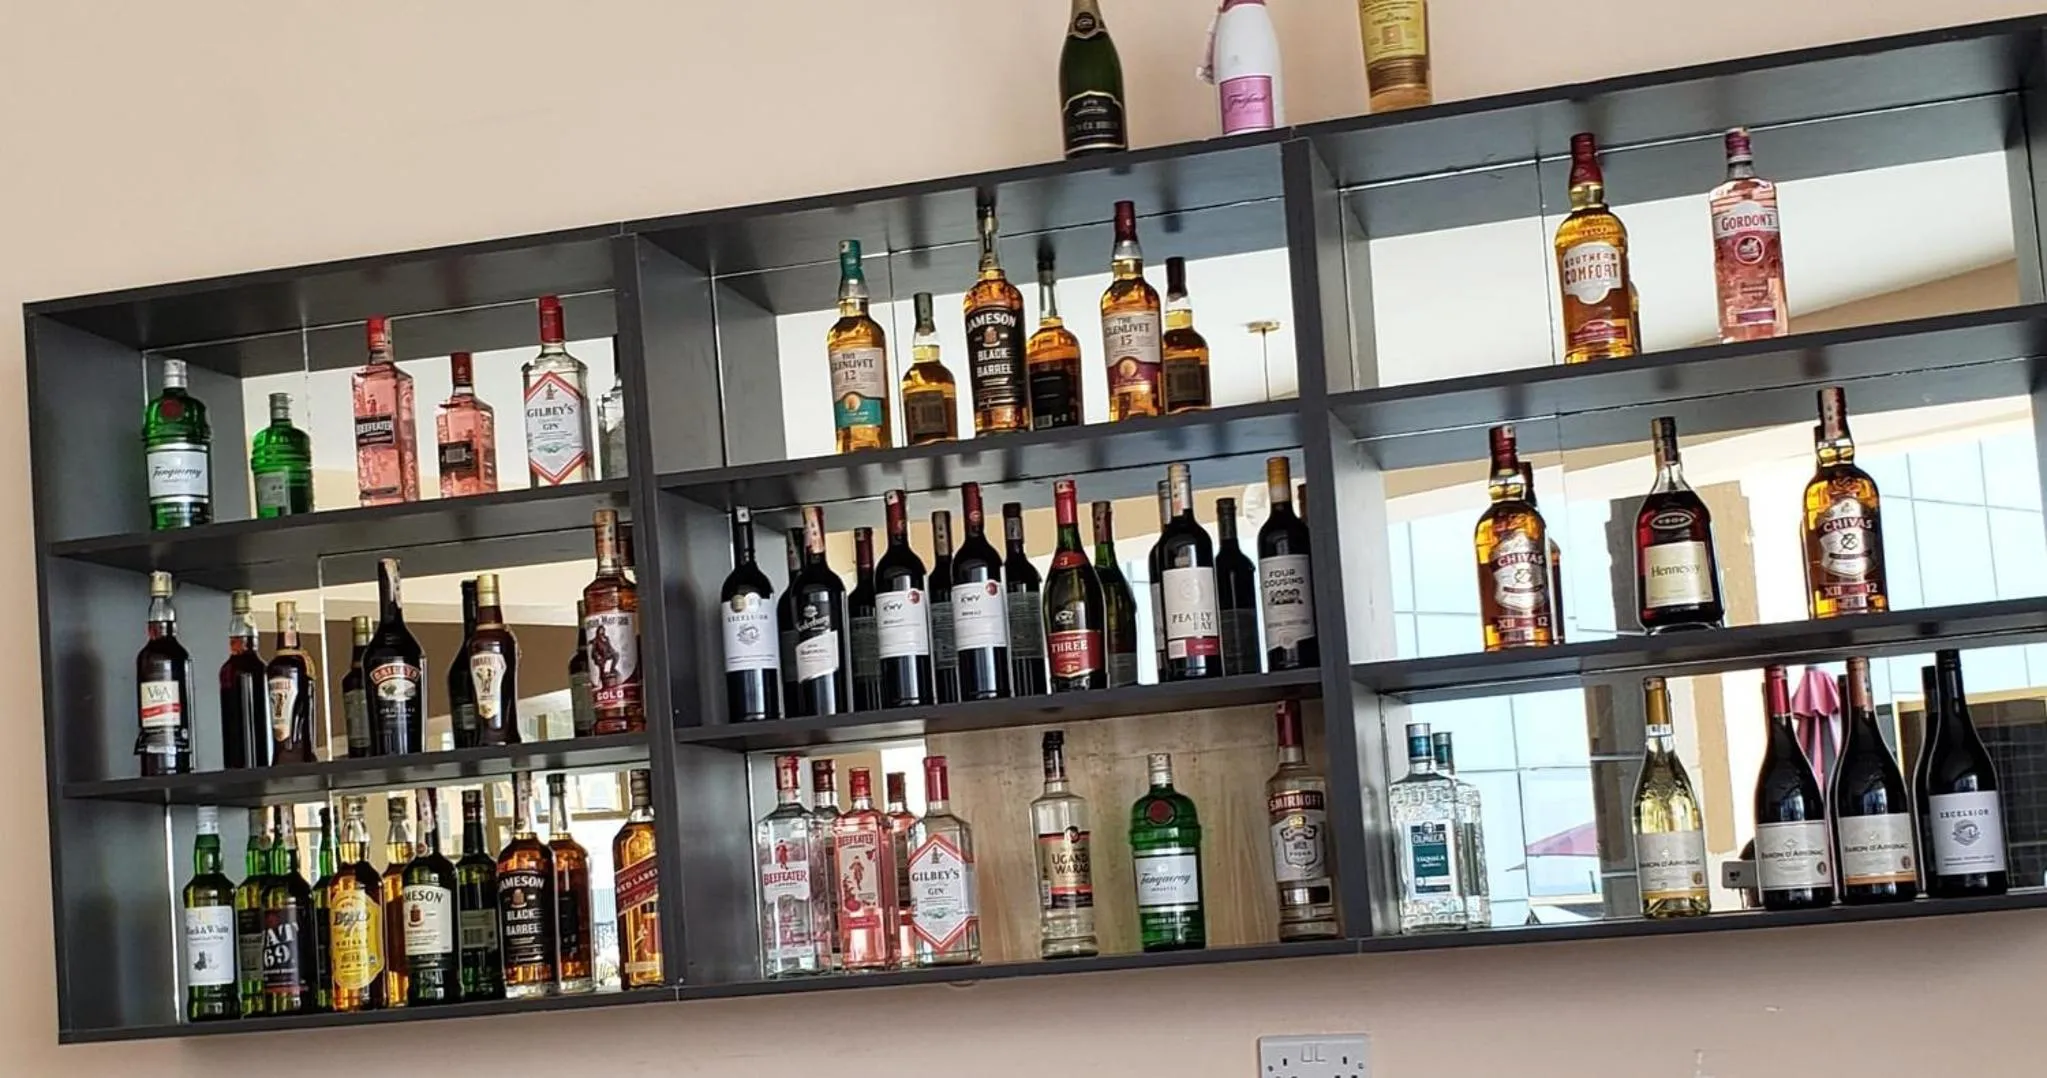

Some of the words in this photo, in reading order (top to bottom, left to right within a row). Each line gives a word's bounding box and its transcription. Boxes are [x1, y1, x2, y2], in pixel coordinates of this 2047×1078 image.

[1564, 252, 1617, 268] SOUTHERN
[1564, 262, 1618, 286] COMFORT
[967, 312, 1017, 333] JAMESON
[1120, 335, 1132, 346] 15
[977, 348, 1009, 362] BLACK
[843, 370, 856, 381] 12
[976, 363, 1013, 378] BARREL
[526, 402, 575, 418] GILBEY'S
[356, 420, 393, 435] BEEFEATER
[1823, 519, 1873, 532] CHIVAS
[1497, 554, 1544, 567] CHIVAS
[1269, 568, 1296, 578] FOUR
[1264, 576, 1305, 588] COUSINS
[1866, 582, 1878, 593] 12
[1051, 640, 1089, 653] THREE
[597, 689, 624, 701] GOLD
[1270, 793, 1322, 811] SMIRNOFF
[1939, 808, 1989, 818] EXCELSIOR
[837, 833, 874, 848] BEEFEATER
[1051, 852, 1090, 865] UGAND
[763, 869, 808, 886] BEEFEATER
[911, 867, 960, 882] GILBEY'S
[927, 887, 944, 896] GIN
[506, 908, 538, 921] BLACK
[263, 921, 299, 946] AT
[506, 923, 539, 936] BARREL
[263, 944, 290, 968] 69
